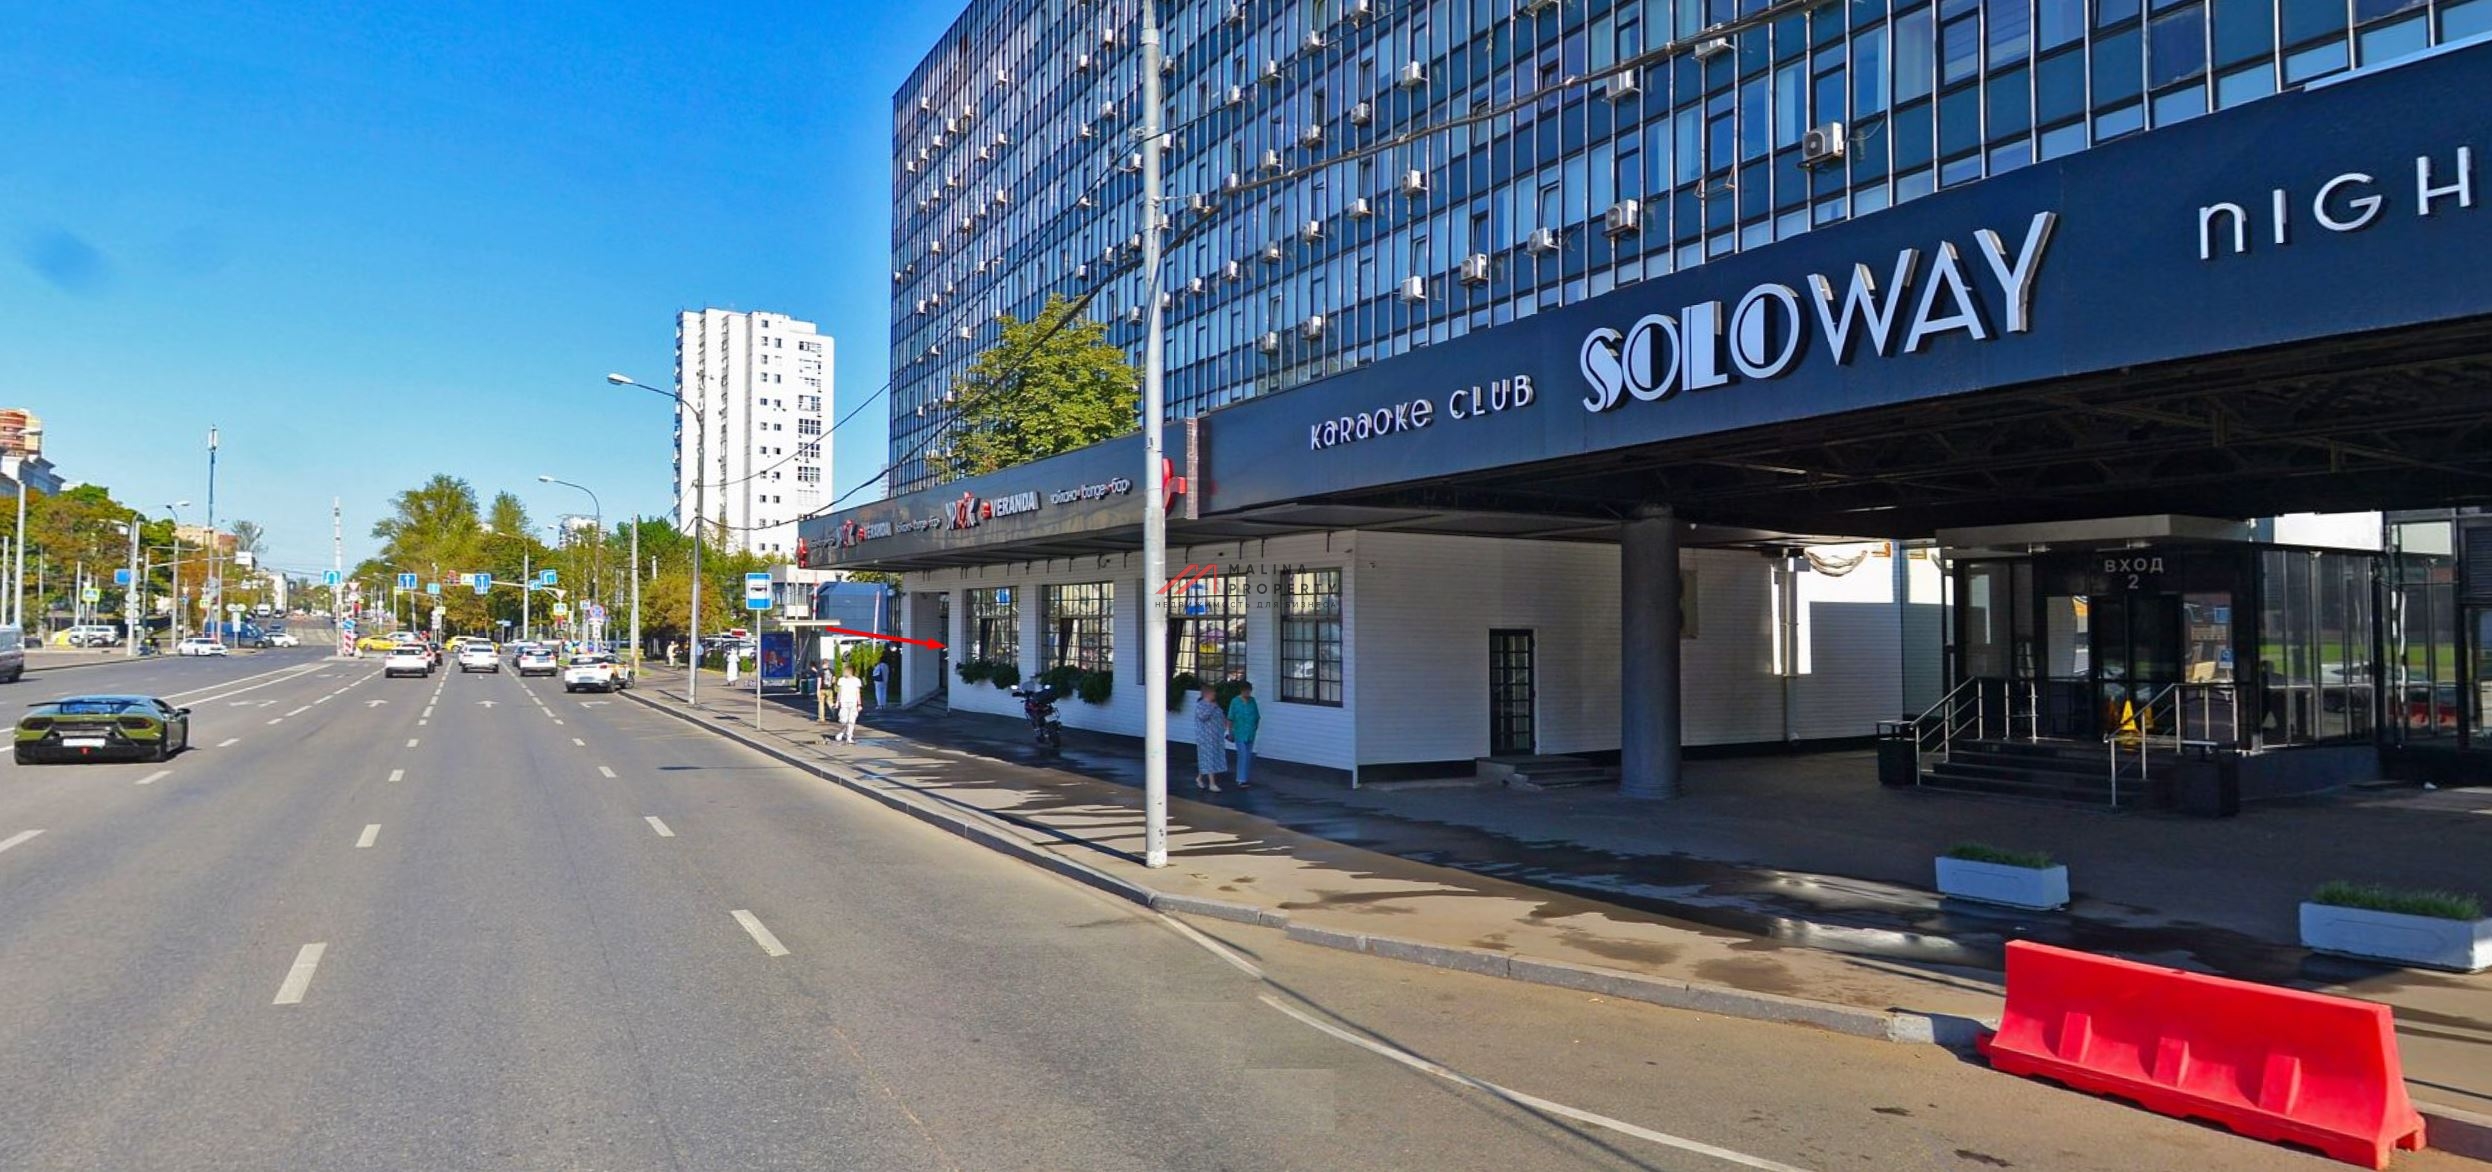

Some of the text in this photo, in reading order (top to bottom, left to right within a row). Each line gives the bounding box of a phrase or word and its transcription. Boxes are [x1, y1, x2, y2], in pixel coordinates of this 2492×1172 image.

[1580, 211, 2056, 413] SOLOWAY
[1449, 374, 1535, 420] CLUB
[991, 490, 1040, 517] VERANDA
[2104, 557, 2164, 574] ВХОД
[2127, 574, 2139, 589] 2
